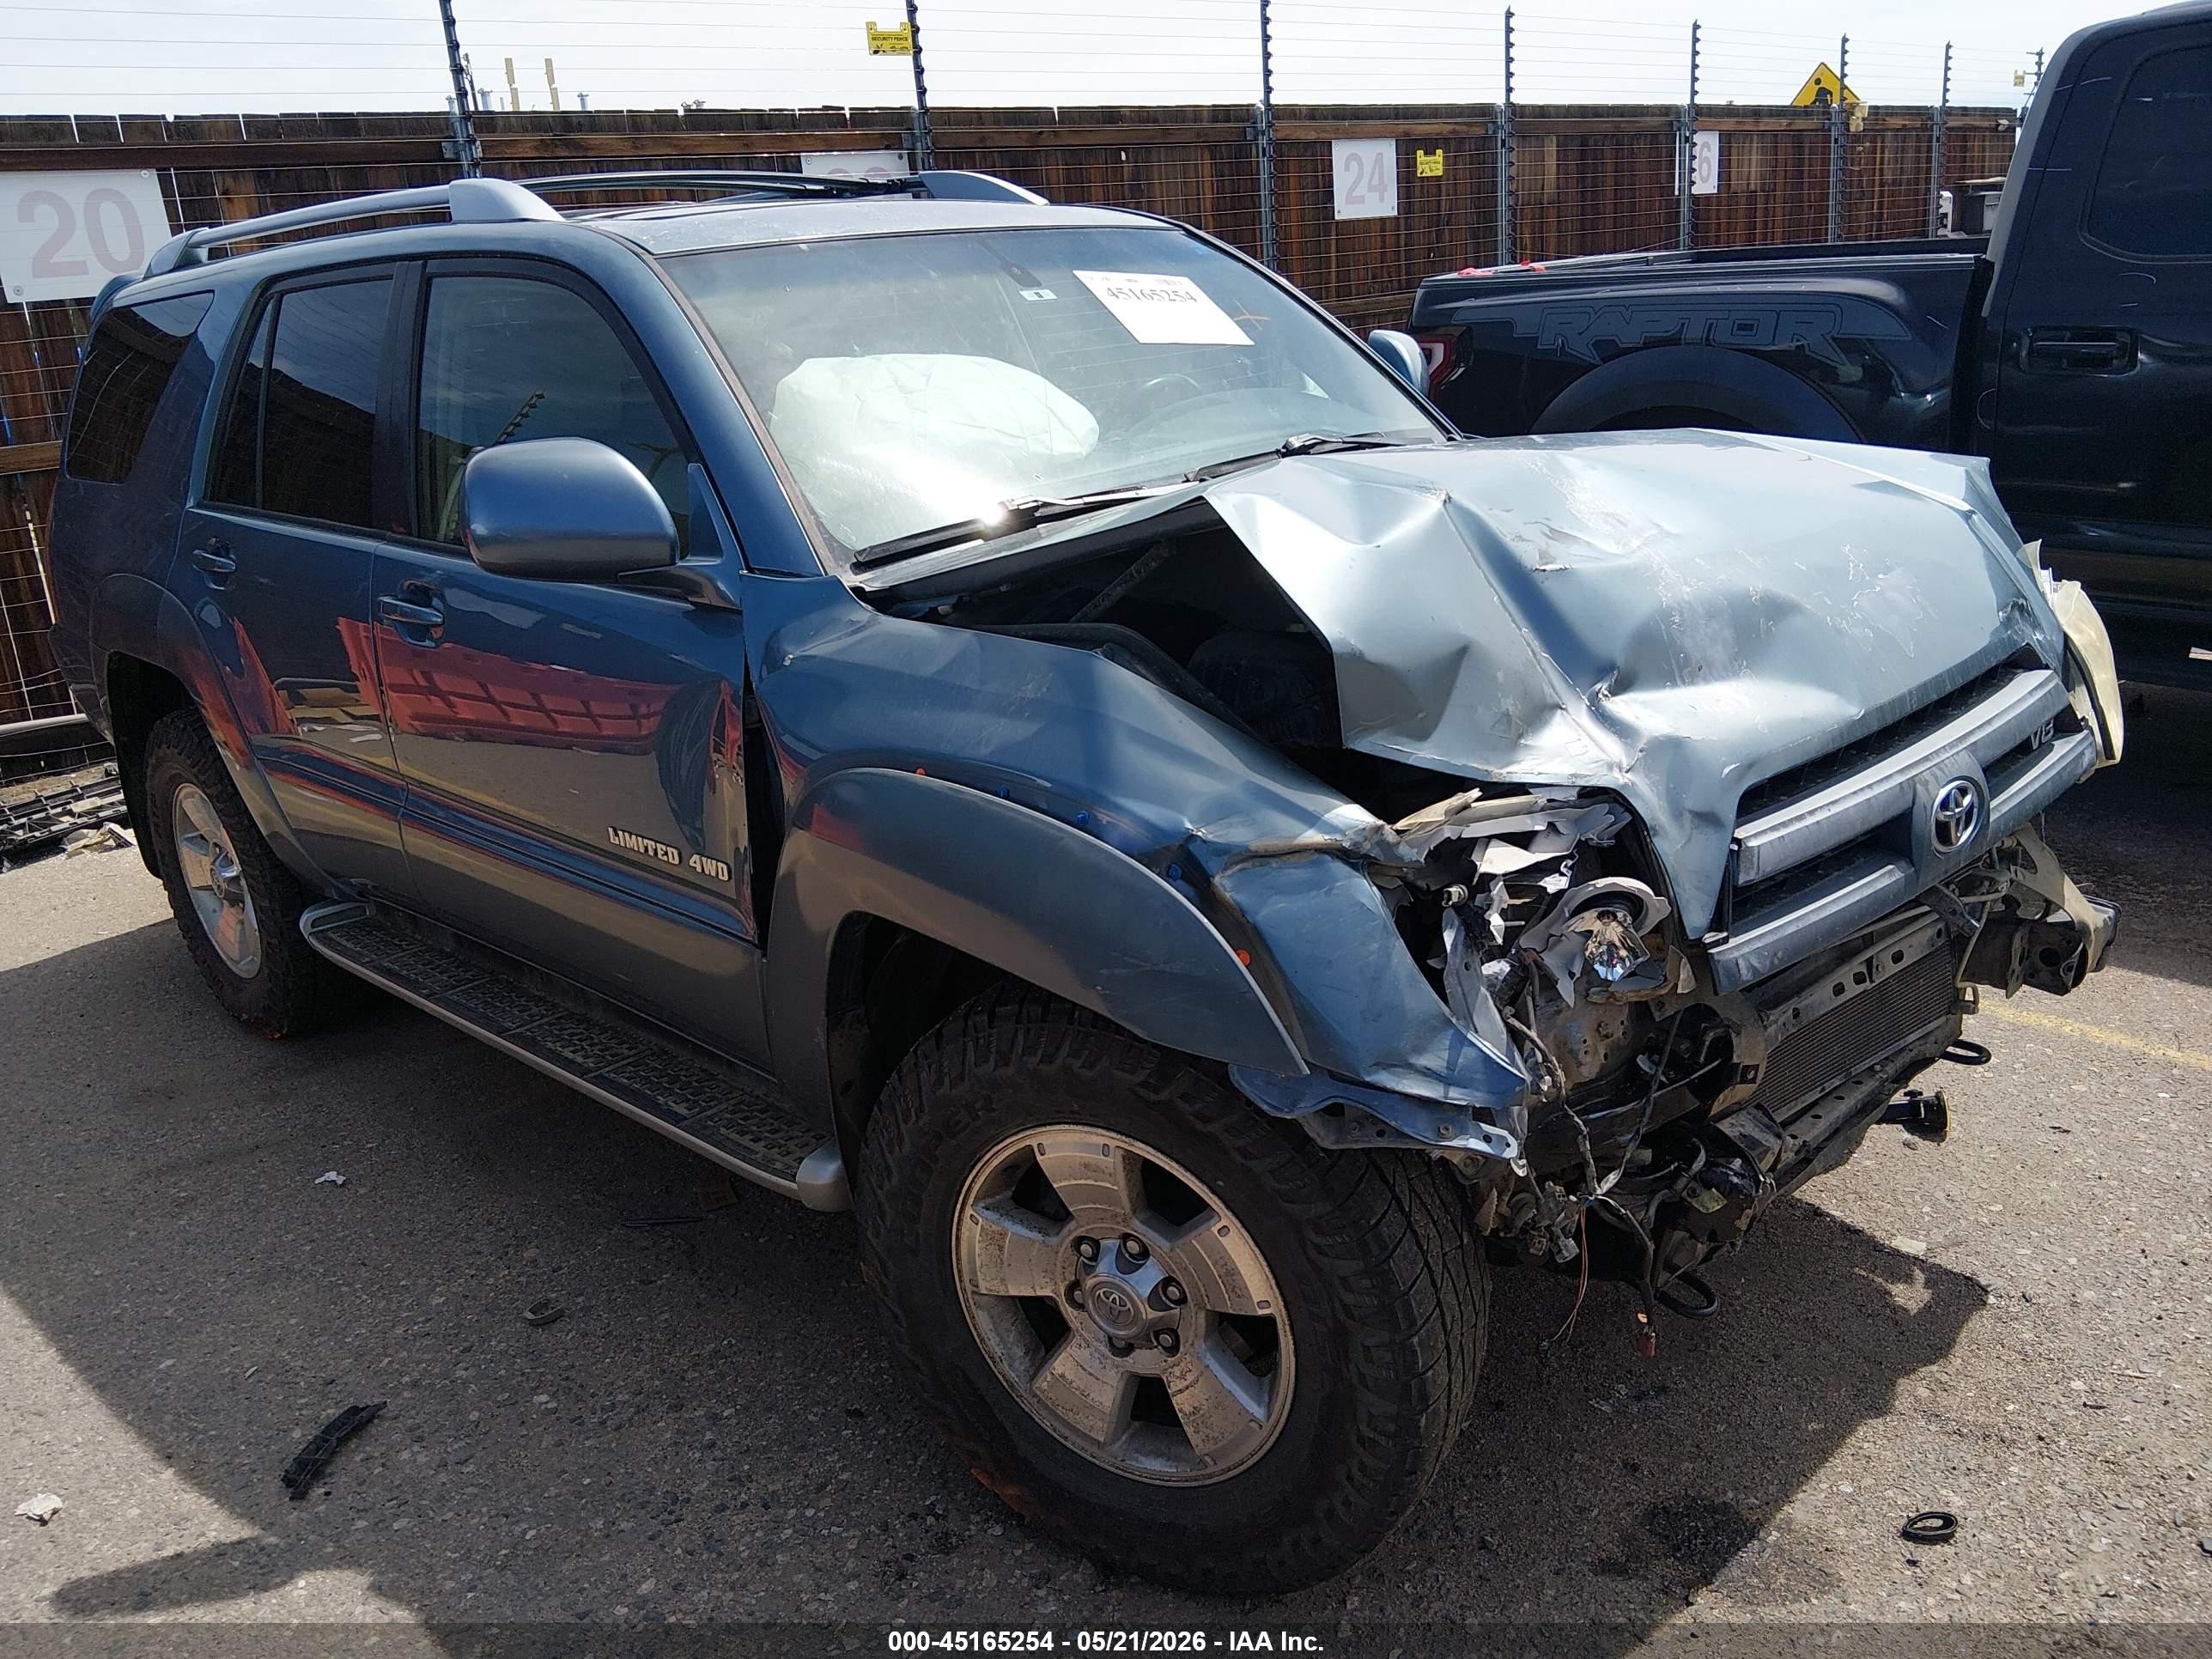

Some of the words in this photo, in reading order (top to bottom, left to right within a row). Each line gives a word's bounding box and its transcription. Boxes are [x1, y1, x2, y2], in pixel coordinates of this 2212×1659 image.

[1344, 151, 1388, 205] 24
[19, 188, 143, 278] 20
[1106, 287, 1198, 302] 45165254
[1538, 307, 1849, 365] RAPTOR
[2030, 720, 2055, 750] V6
[607, 826, 681, 866] LIMITED
[689, 854, 732, 882] 4WD
